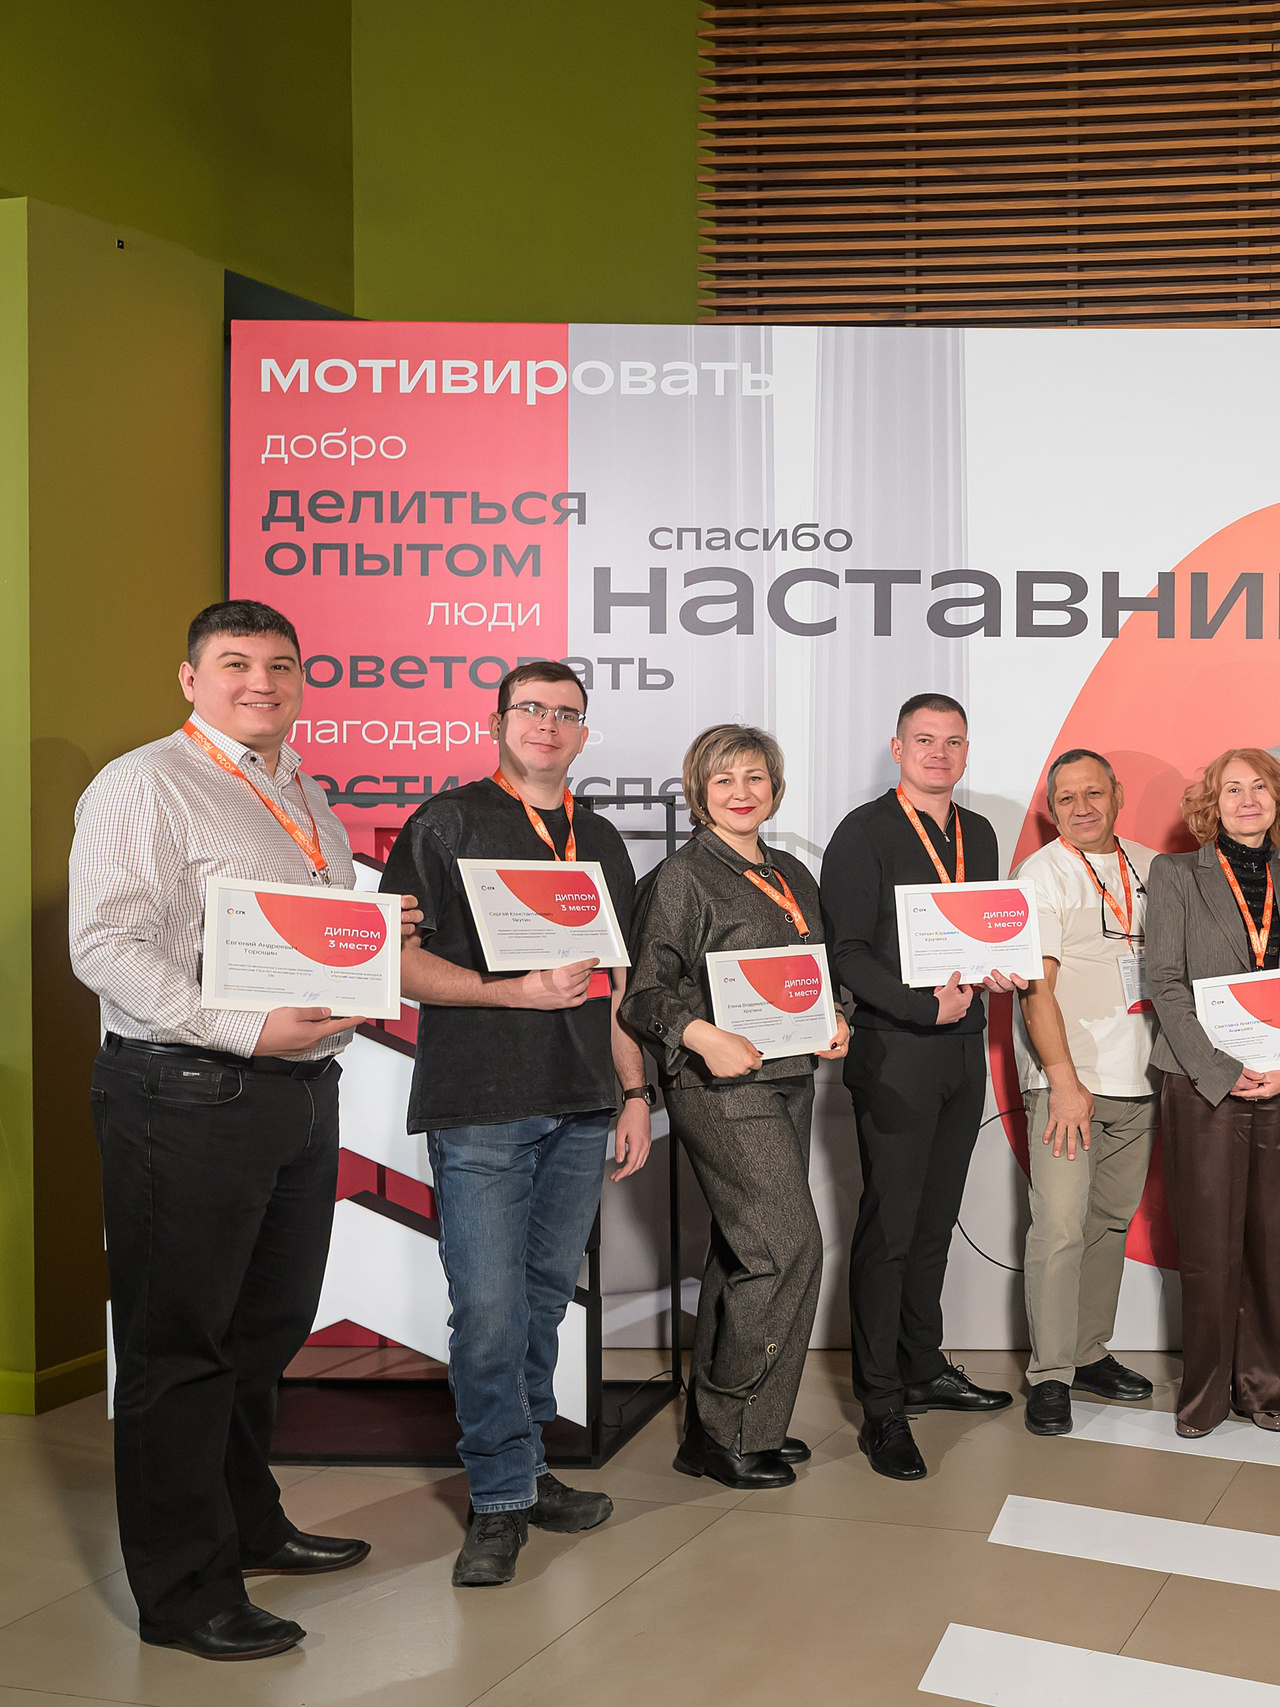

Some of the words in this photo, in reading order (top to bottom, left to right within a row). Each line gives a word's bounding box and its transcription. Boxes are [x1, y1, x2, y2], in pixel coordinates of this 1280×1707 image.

[261, 357, 775, 406] мотивировать
[261, 427, 407, 467] добро
[261, 489, 587, 532] делиться
[648, 523, 854, 553] спасибо
[264, 541, 541, 578] опытом
[427, 601, 541, 632] люди
[302, 654, 675, 691] оветоать
[215, 753, 236, 774] 2026
[272, 805, 291, 826] 2026
[912, 817, 924, 834] 2026
[937, 864, 948, 882] 2026
[1224, 868, 1234, 882] 2026
[555, 893, 597, 902] ДИПЛОМ
[764, 885, 781, 901] 2026
[560, 904, 567, 912] 3
[1104, 894, 1118, 910] 2026
[982, 910, 1025, 920] ДИПЛОМ
[994, 920, 1023, 928] место
[323, 926, 381, 940] ДИПЛОМ
[225, 939, 256, 948] Евгений
[328, 940, 336, 949] 3
[339, 941, 377, 952] место
[784, 977, 820, 989] ДИПЛОМ
[794, 989, 818, 998] место
